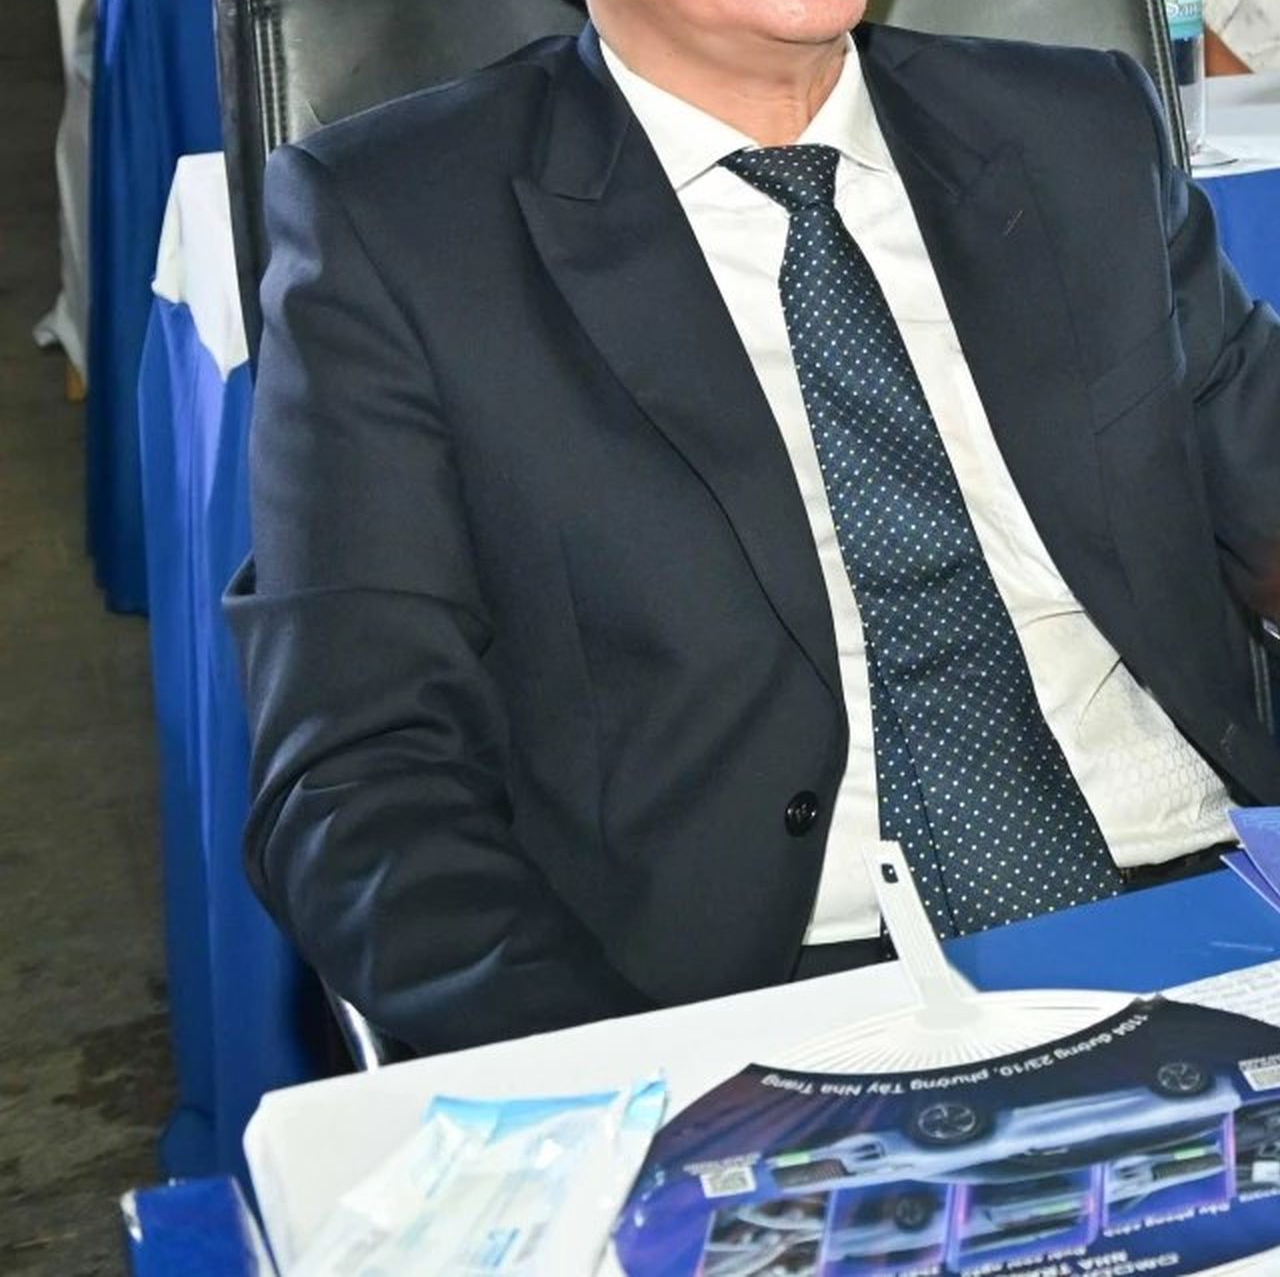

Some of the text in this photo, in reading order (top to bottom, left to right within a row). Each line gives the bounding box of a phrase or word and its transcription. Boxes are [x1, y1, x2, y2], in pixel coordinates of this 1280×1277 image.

[1111, 1014, 1148, 1036] 1104
[761, 1073, 814, 1096] Trang
[820, 1083, 863, 1097] Nha
